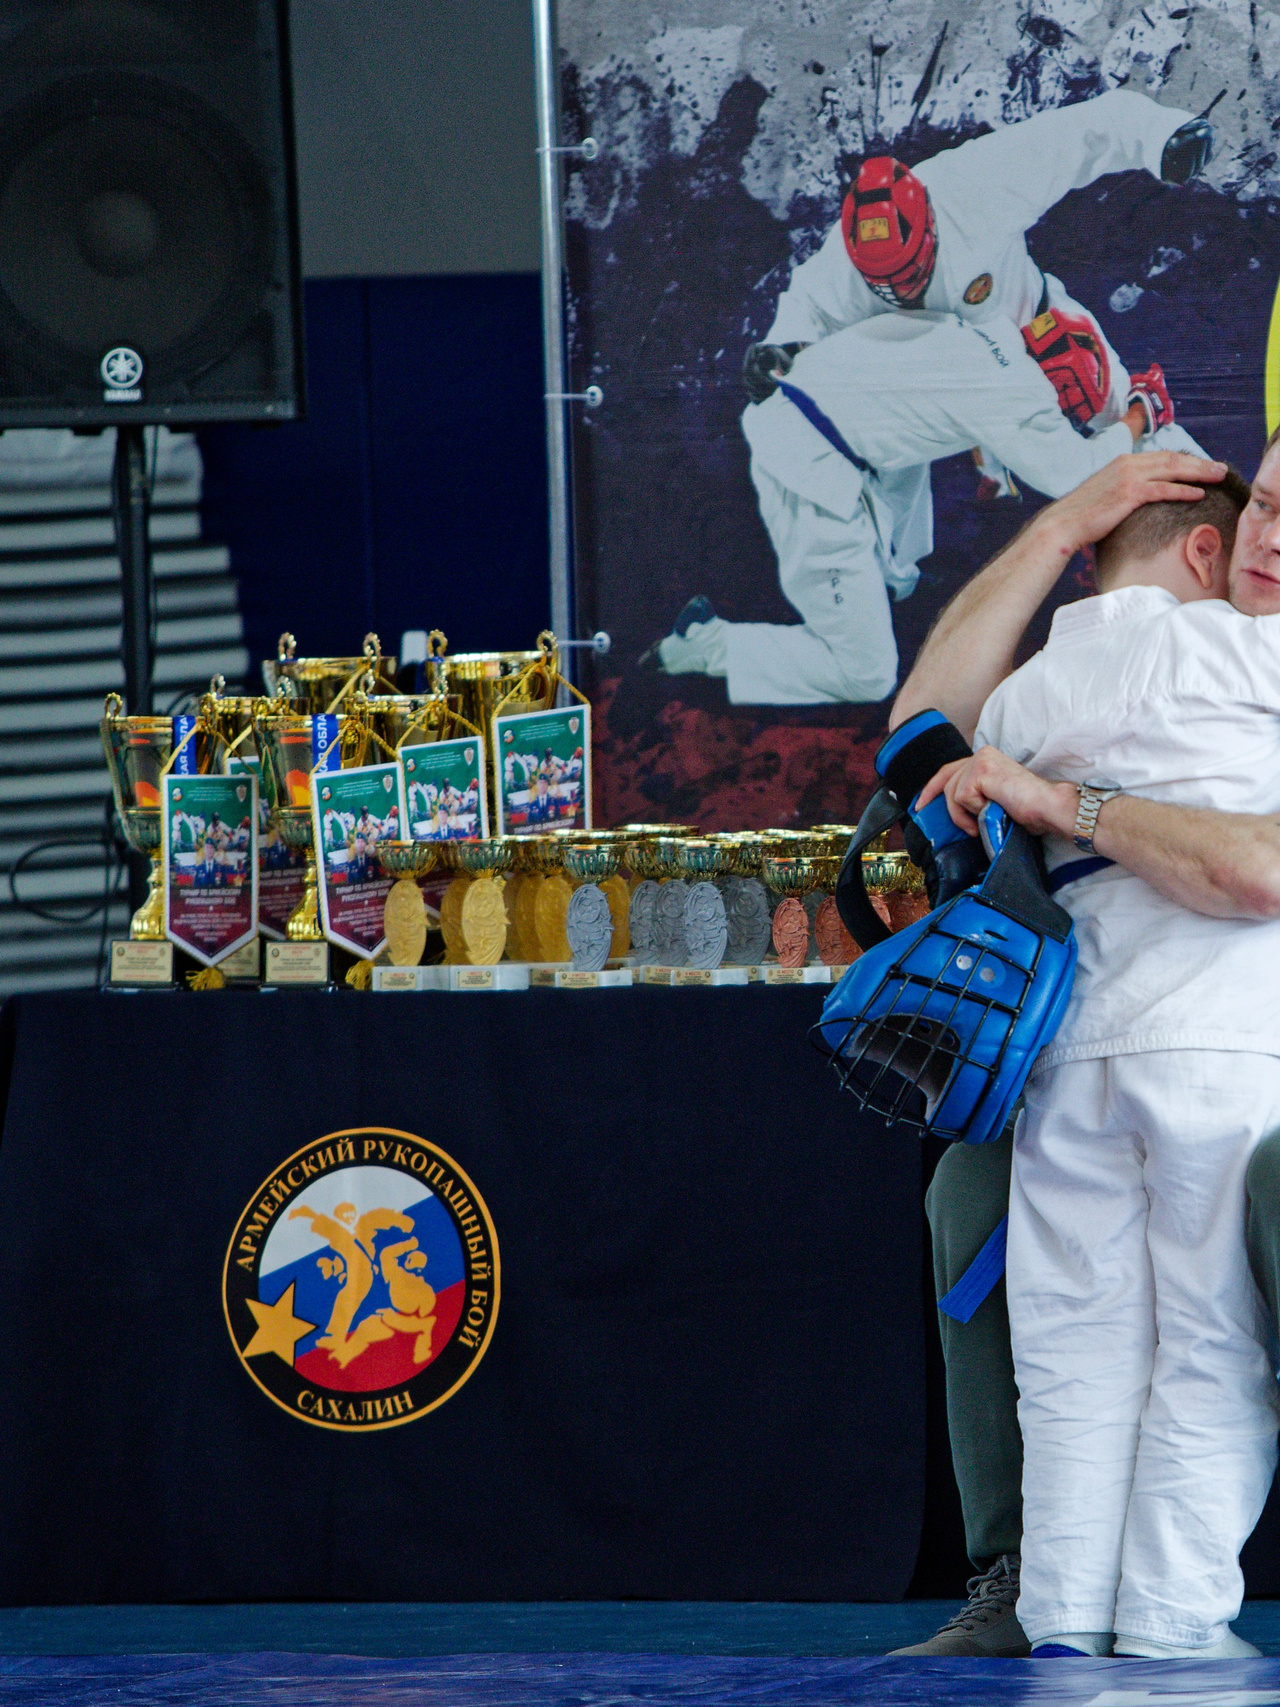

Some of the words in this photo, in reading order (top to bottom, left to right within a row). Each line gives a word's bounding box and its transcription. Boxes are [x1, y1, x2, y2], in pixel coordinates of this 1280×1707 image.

[236, 1138, 356, 1272] АРМЕЙСКИЙ
[363, 1139, 491, 1281] РУКОПАШНЫЙ
[458, 1289, 488, 1349] БОЙ
[297, 1390, 414, 1422] САХАЛИН
